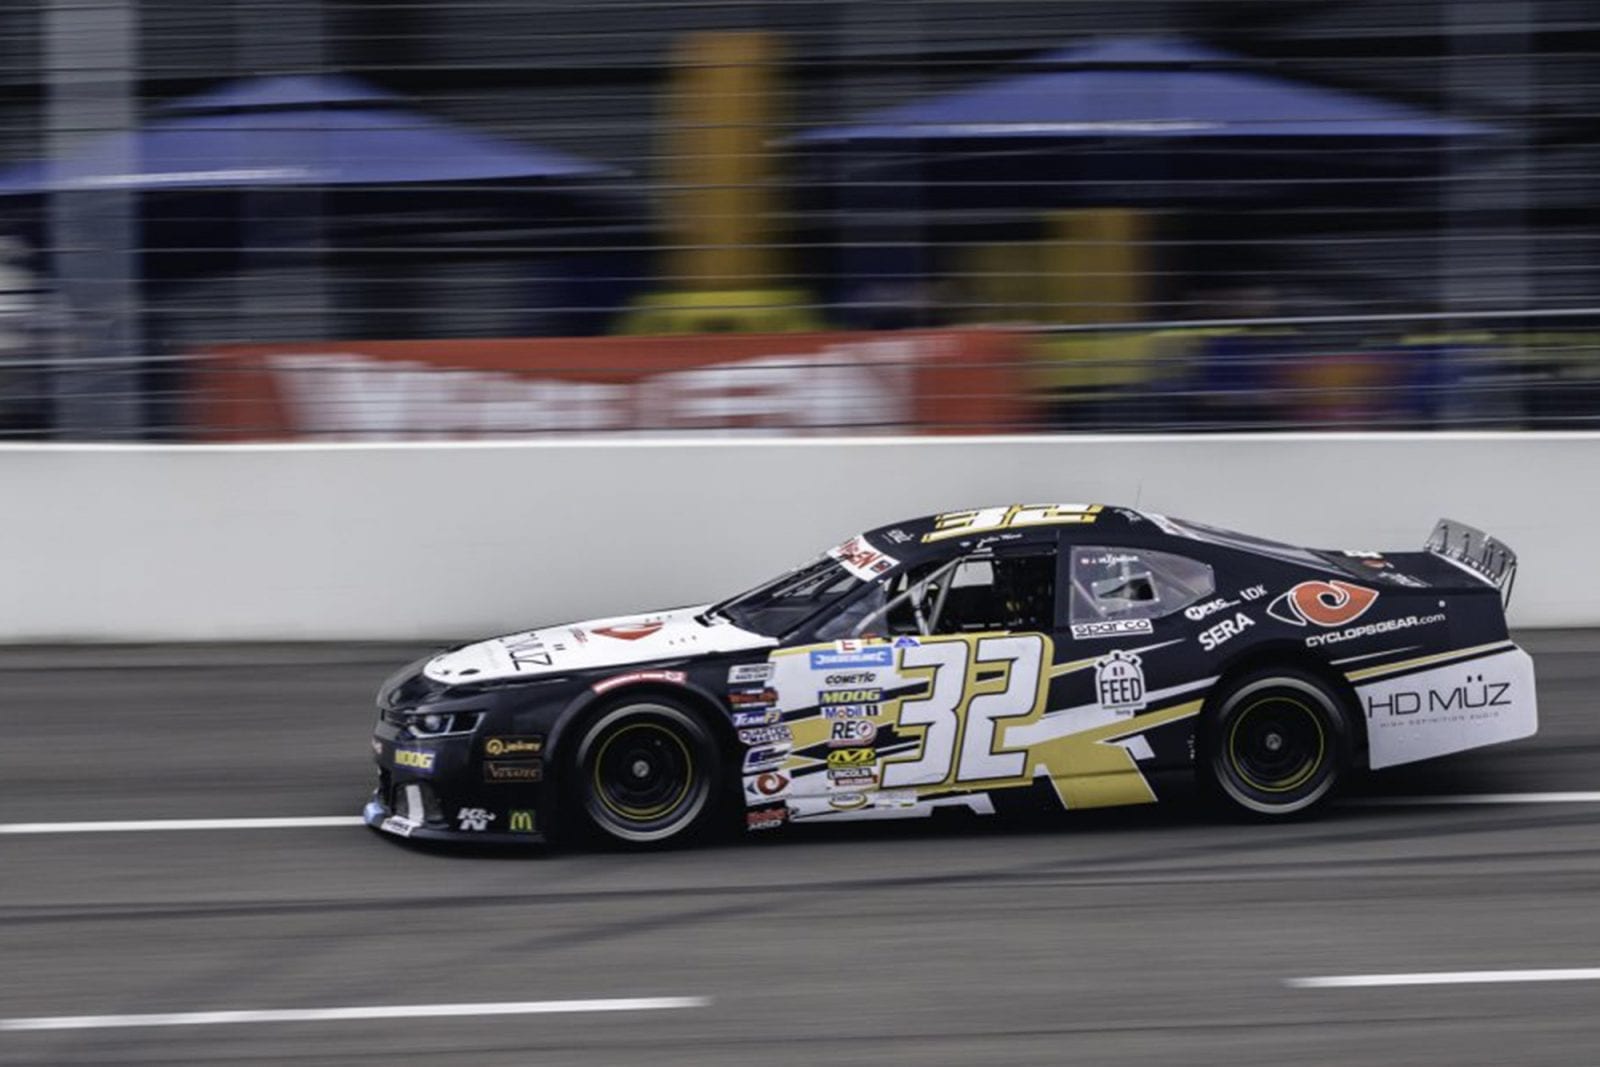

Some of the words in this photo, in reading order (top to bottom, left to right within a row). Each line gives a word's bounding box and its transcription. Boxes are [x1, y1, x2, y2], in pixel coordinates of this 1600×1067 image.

[1198, 612, 1256, 651] SERA
[822, 690, 880, 703] MOOG
[1100, 677, 1142, 705] FEED
[1368, 692, 1421, 718] HD
[1428, 674, 1512, 712] MÜZ
[880, 634, 1044, 790] 32
